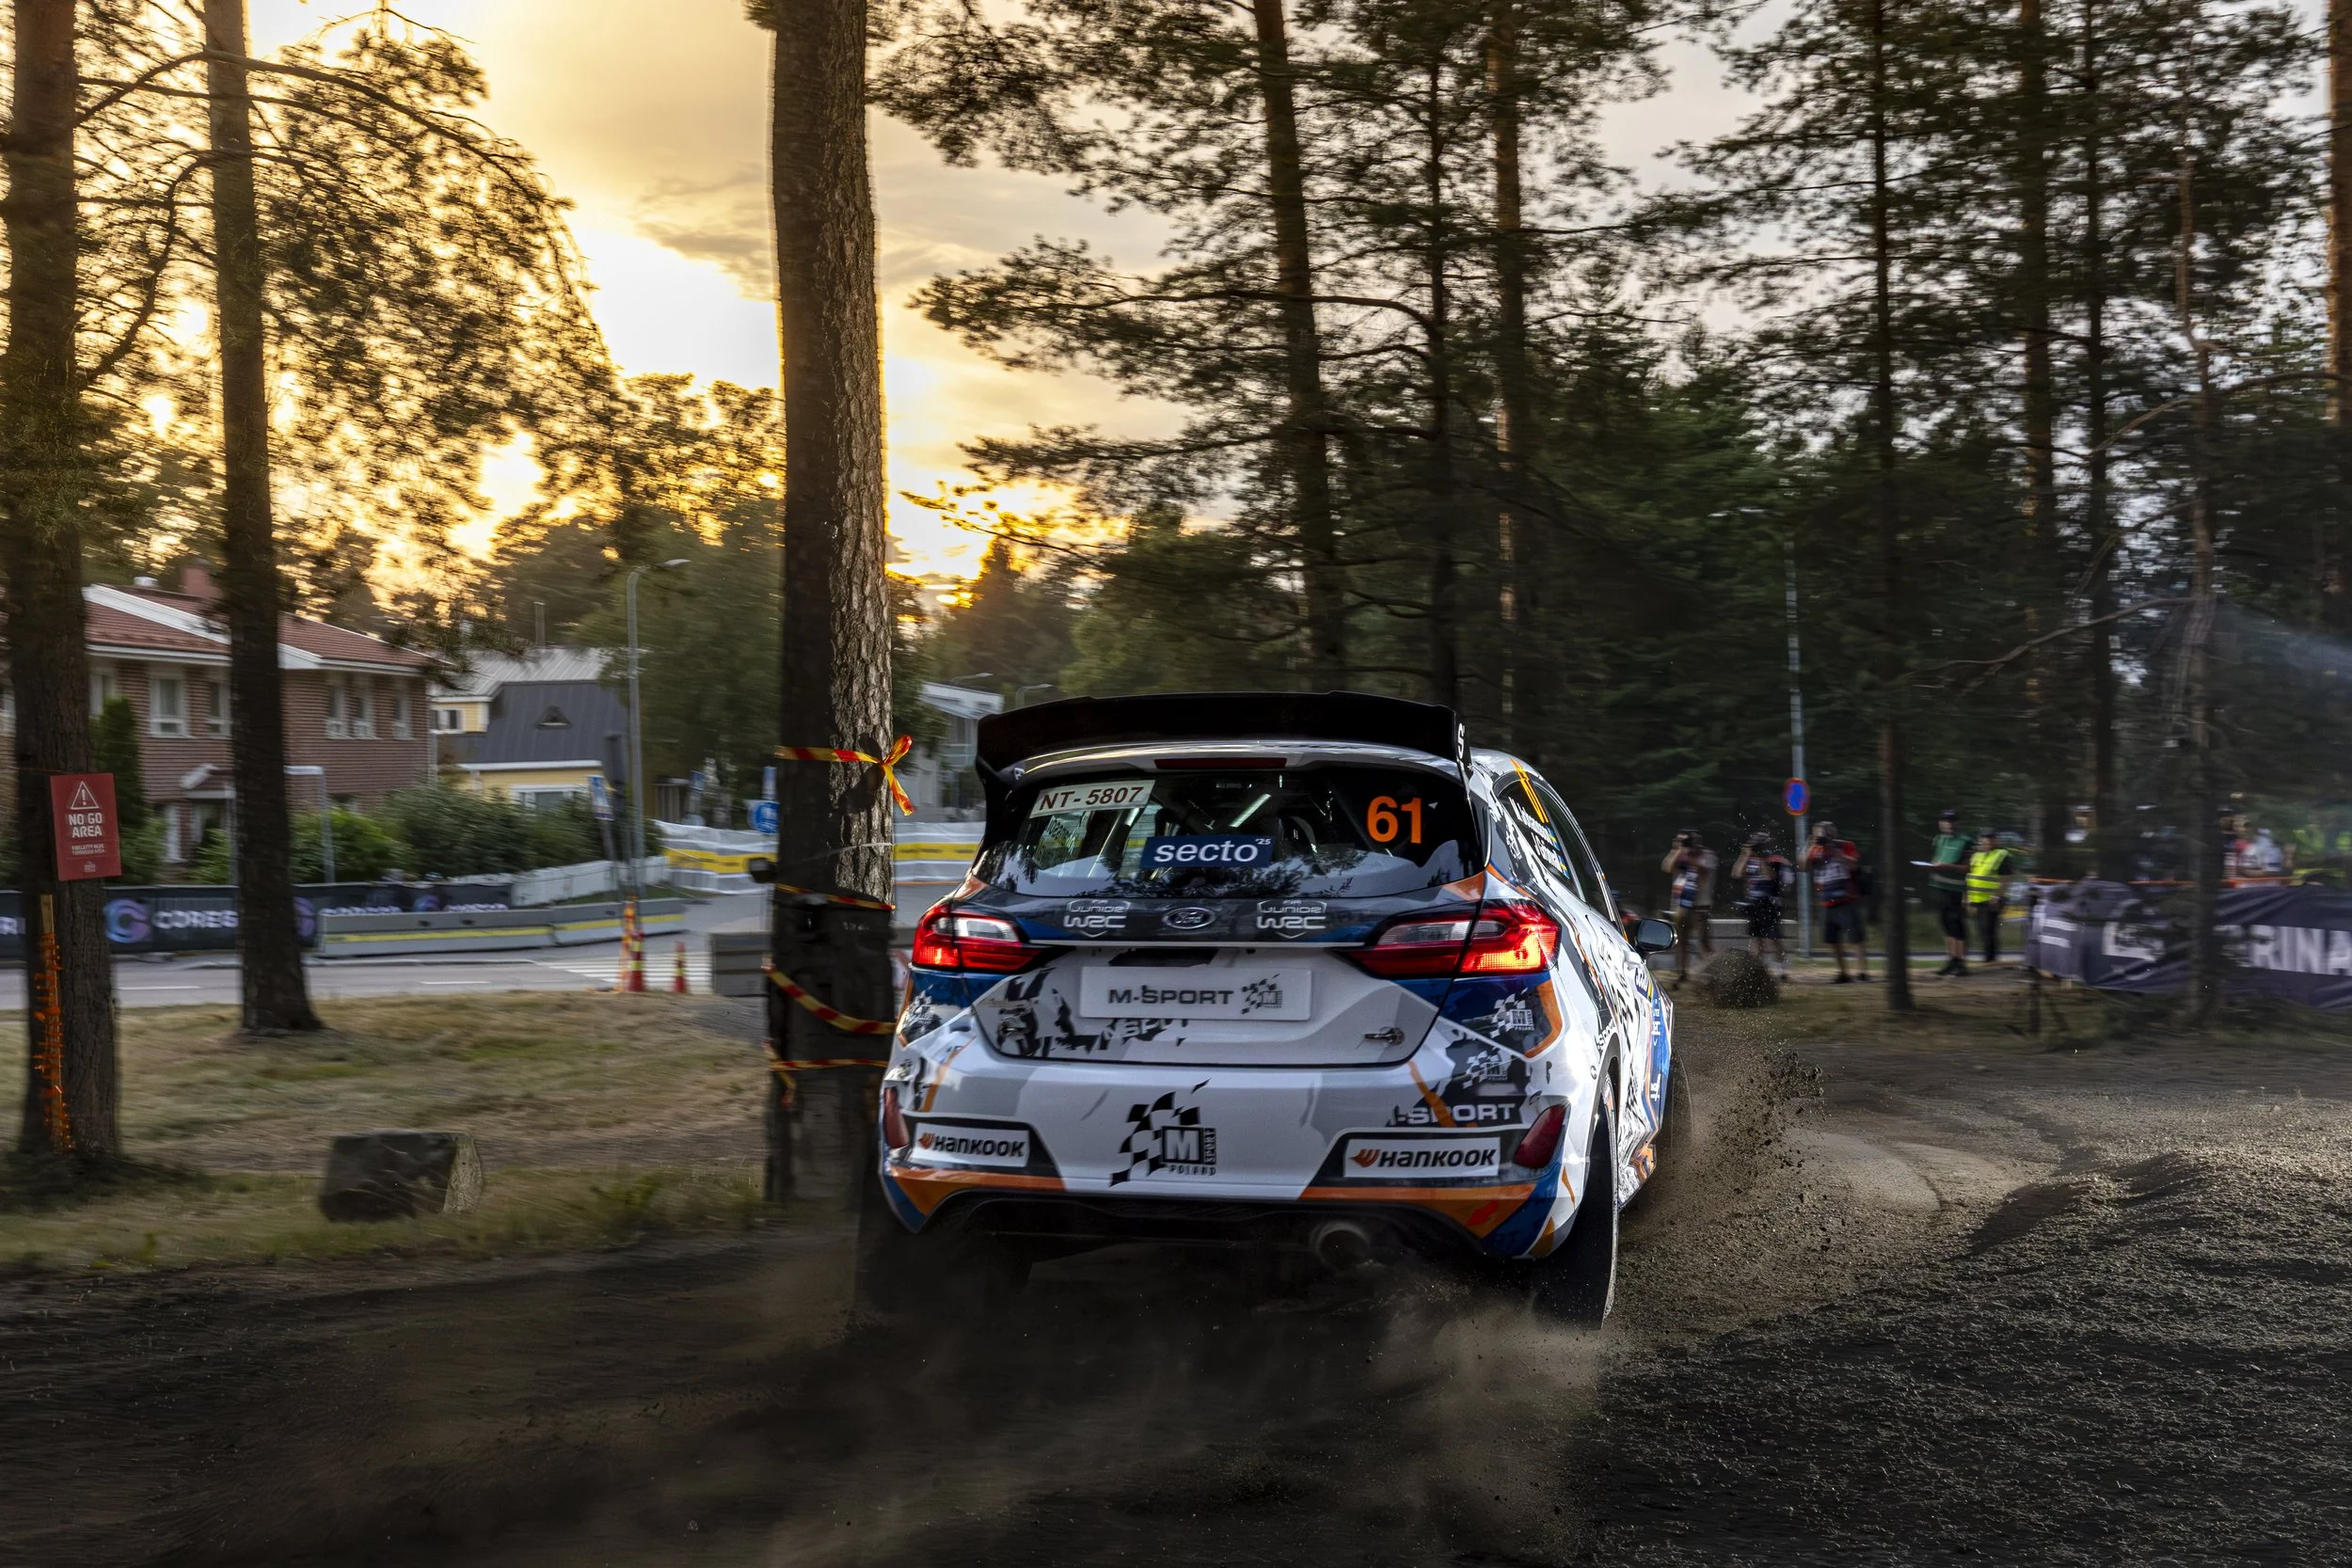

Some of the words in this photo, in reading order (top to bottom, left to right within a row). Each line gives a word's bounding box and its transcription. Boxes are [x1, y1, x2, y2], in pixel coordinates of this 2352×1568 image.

[69, 814, 85, 825] NO
[87, 813, 103, 824] GO
[1367, 796, 1422, 844] 61
[72, 825, 103, 838] AREA
[1153, 840, 1259, 863] secto
[152, 910, 239, 929] CORES
[1064, 915, 1127, 928] WRC
[1256, 915, 1327, 929] WRC
[1107, 989, 1234, 1006] M-SPORT
[1167, 1129, 1200, 1161] M
